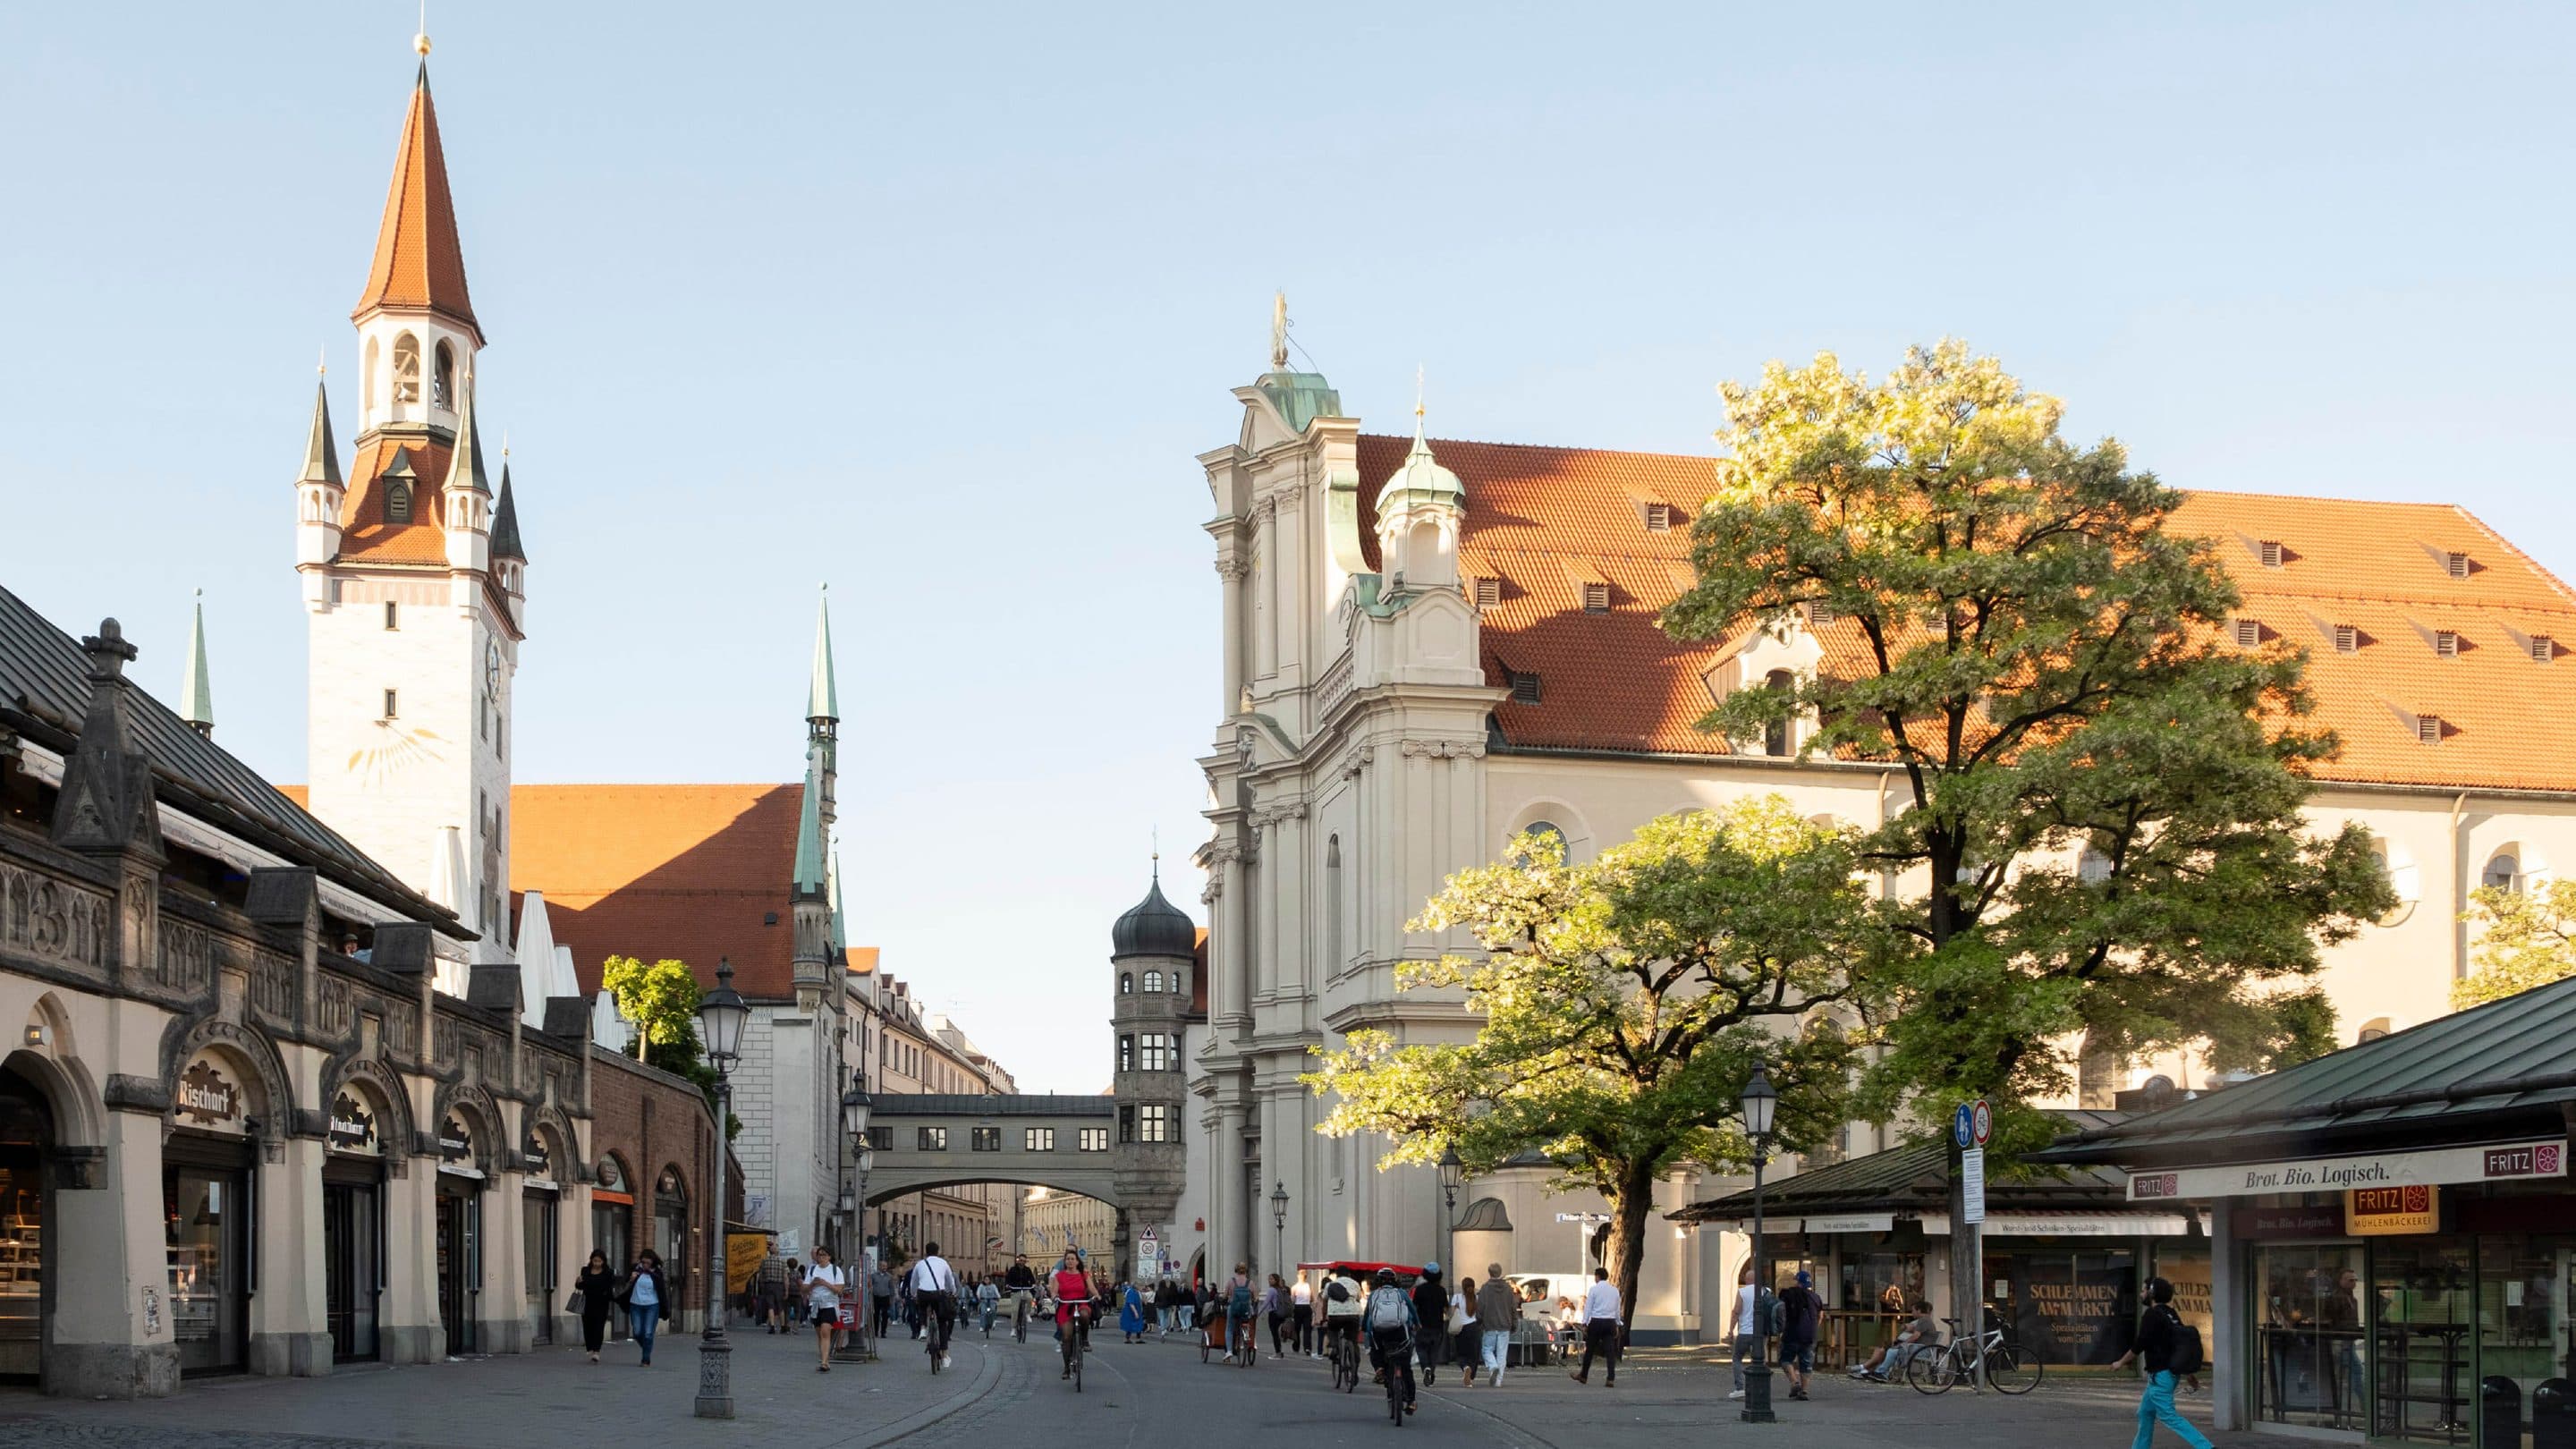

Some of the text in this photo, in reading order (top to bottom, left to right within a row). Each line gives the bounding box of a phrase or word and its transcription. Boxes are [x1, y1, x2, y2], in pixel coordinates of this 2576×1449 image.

[180, 1080, 229, 1113] Rischart
[2489, 1153, 2529, 1172] FRITZ
[2245, 1163, 2390, 1189] Brot. Bio. Logisch.
[2137, 1179, 2162, 1193] FRITZ
[2359, 1190, 2398, 1209] FRITZ
[2354, 1216, 2431, 1229] MÜHLENBÄCKEREI
[2030, 1284, 2118, 1300] SCHLEMMEN
